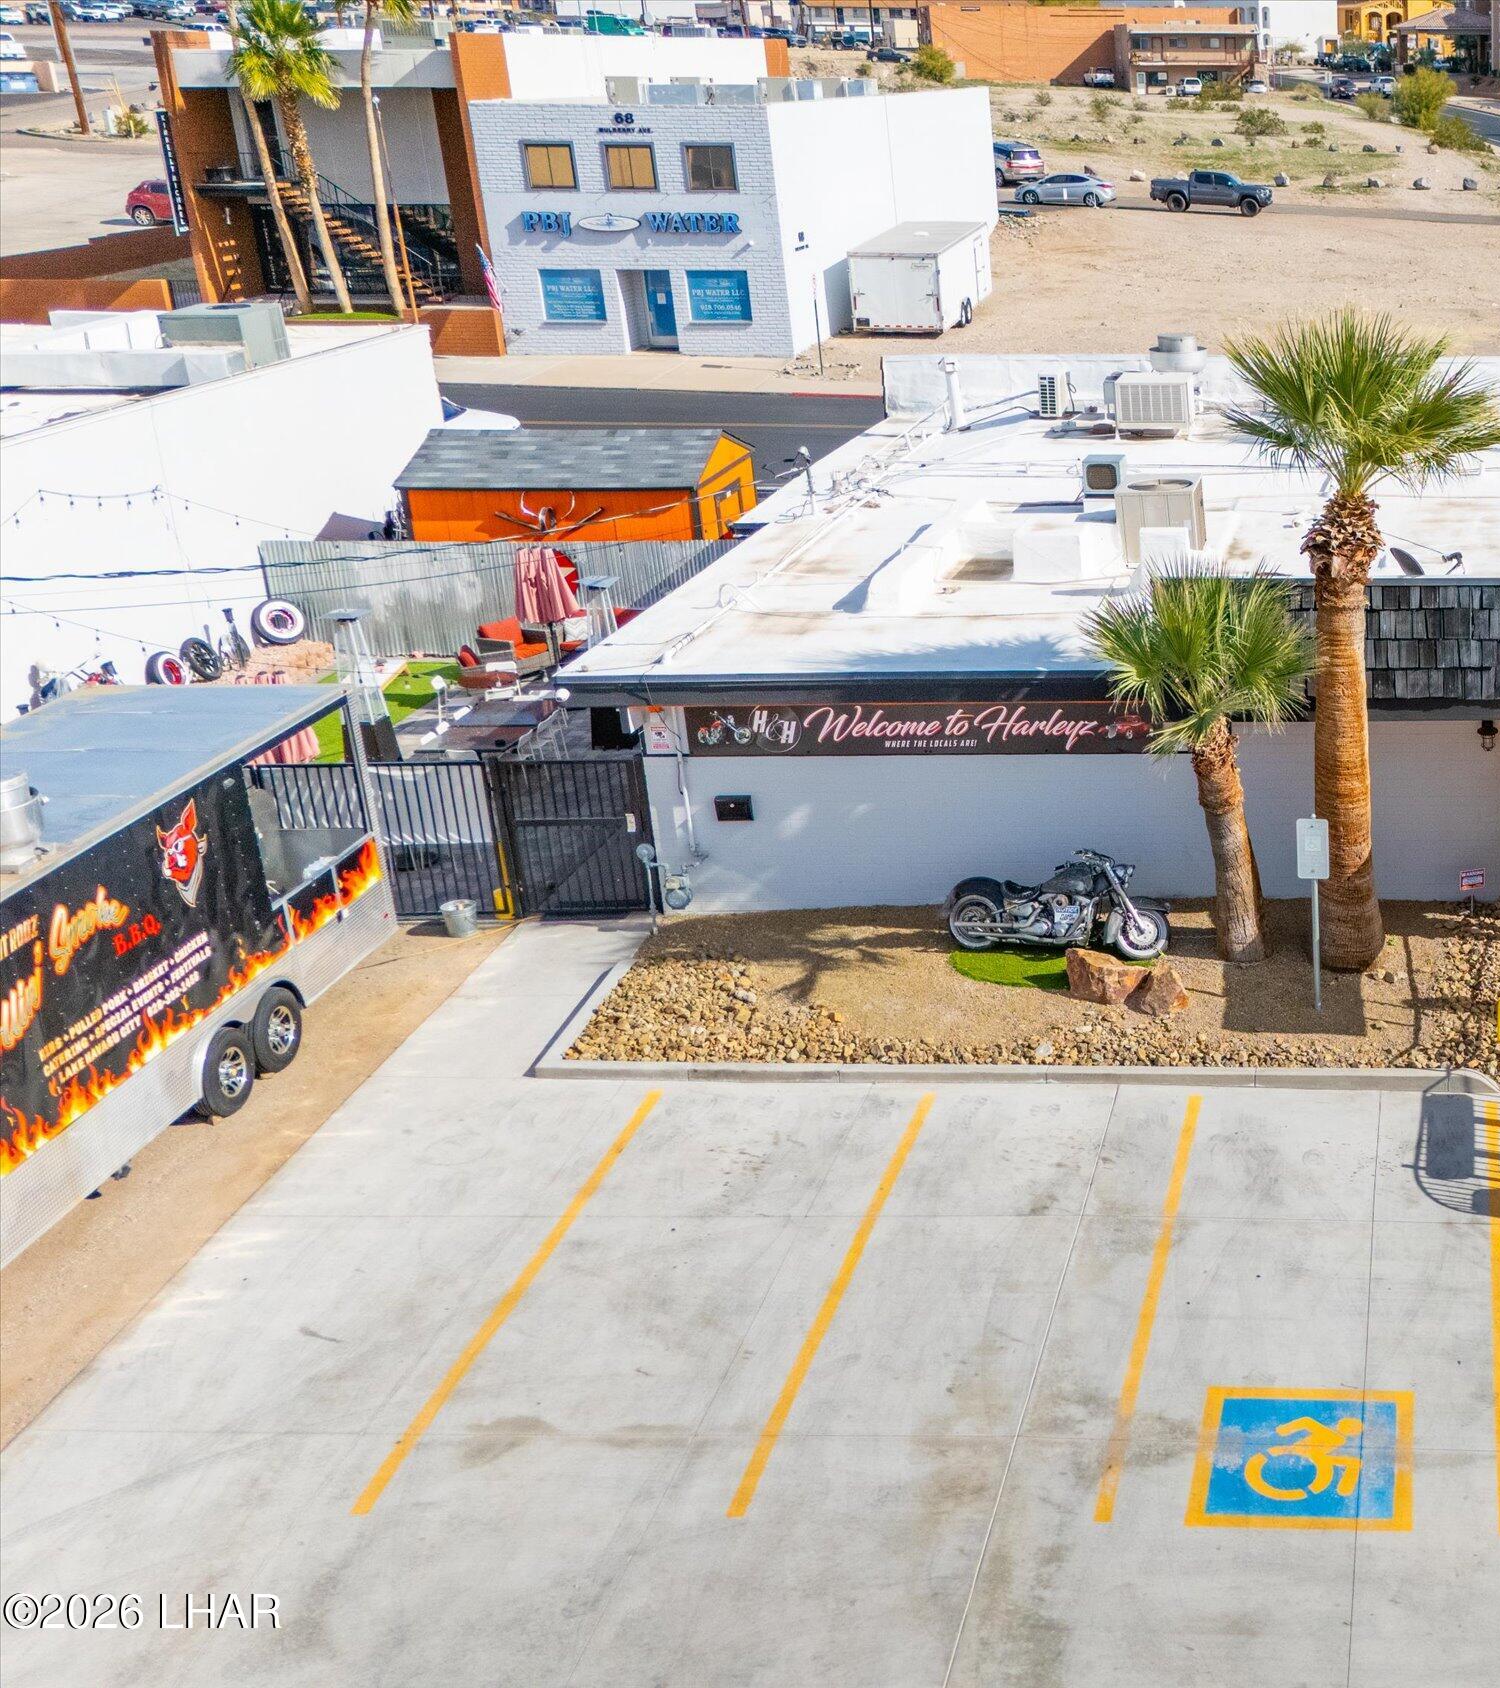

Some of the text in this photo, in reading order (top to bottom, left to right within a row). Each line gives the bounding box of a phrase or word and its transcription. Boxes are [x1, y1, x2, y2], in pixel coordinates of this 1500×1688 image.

[614, 112, 635, 125] 68
[520, 211, 743, 239] PBJ WATER
[692, 288, 704, 297] PBJ
[705, 289, 730, 297] WATER
[803, 705, 1099, 751] Welcome to Harleyz
[884, 739, 978, 748] WHERE THE LOCALS ARE!
[101, 989, 129, 1016] PORK
[59, 1056, 87, 1084] LAKE
[84, 1030, 121, 1066] HAVASU
[119, 1014, 142, 1038] CITY
